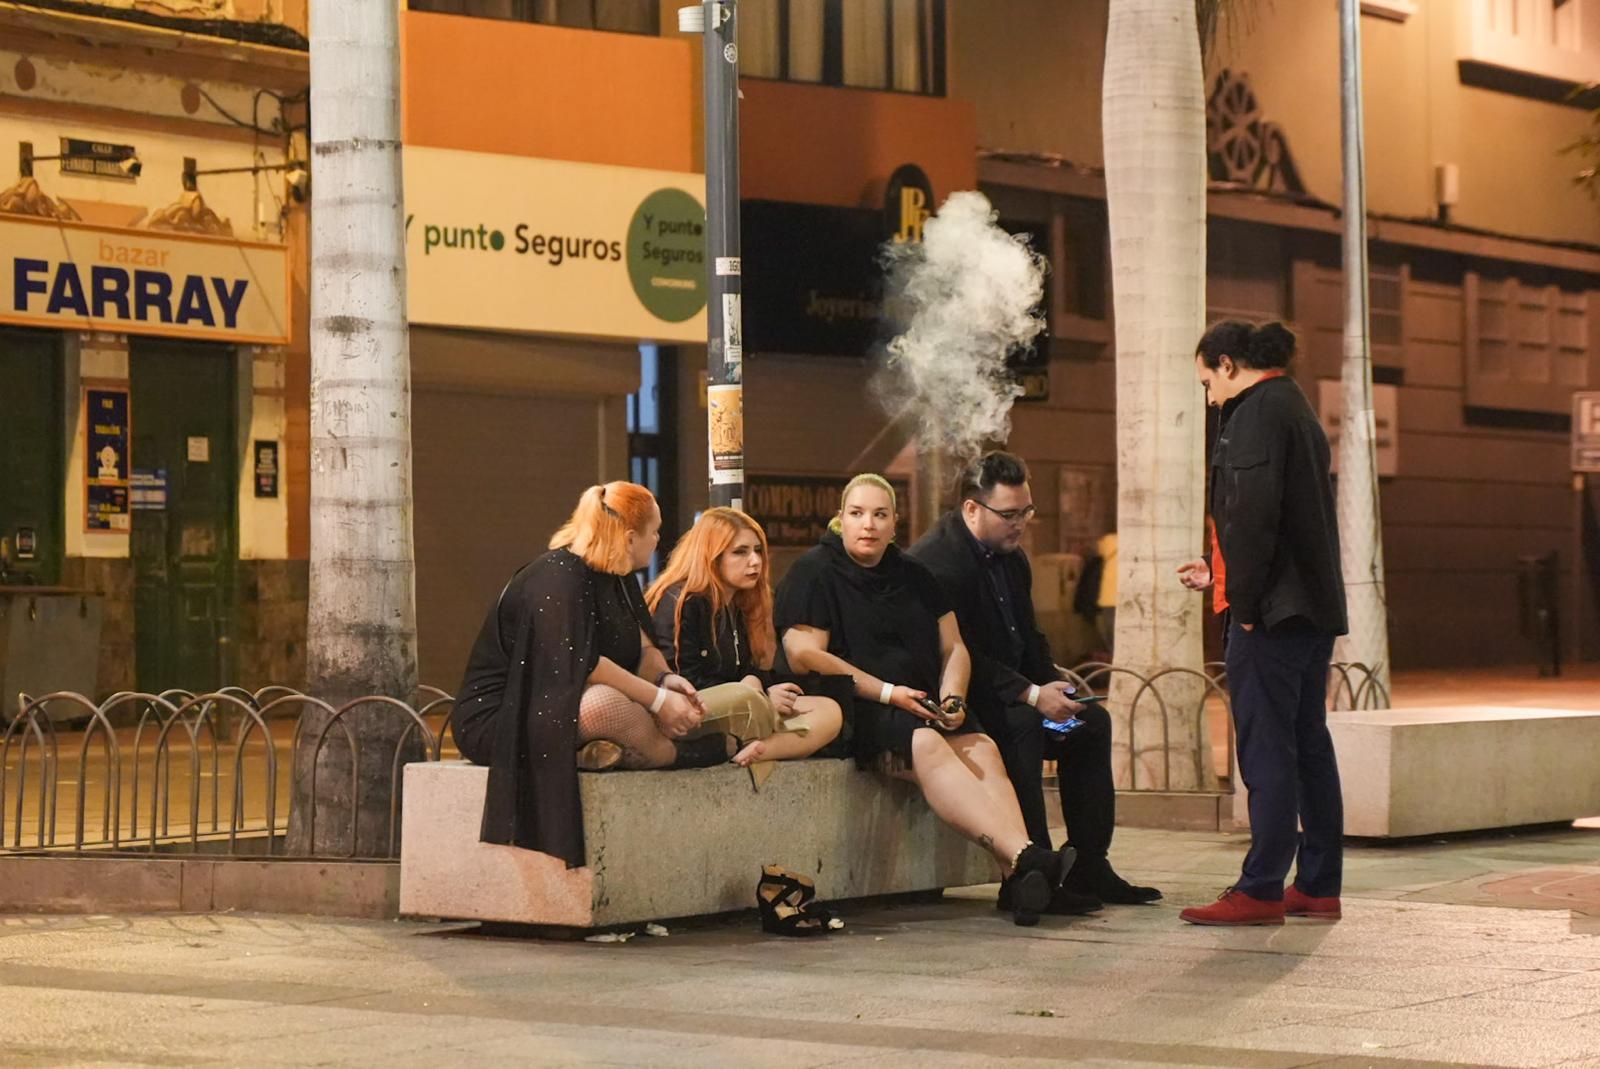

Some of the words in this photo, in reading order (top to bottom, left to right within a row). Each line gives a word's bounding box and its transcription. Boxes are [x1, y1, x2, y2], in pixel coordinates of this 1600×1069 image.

[642, 213, 654, 231] Y
[99, 239, 170, 268] bazar
[514, 223, 622, 266] Seguros
[642, 240, 704, 267] Seguros
[13, 257, 249, 329] FARRAY
